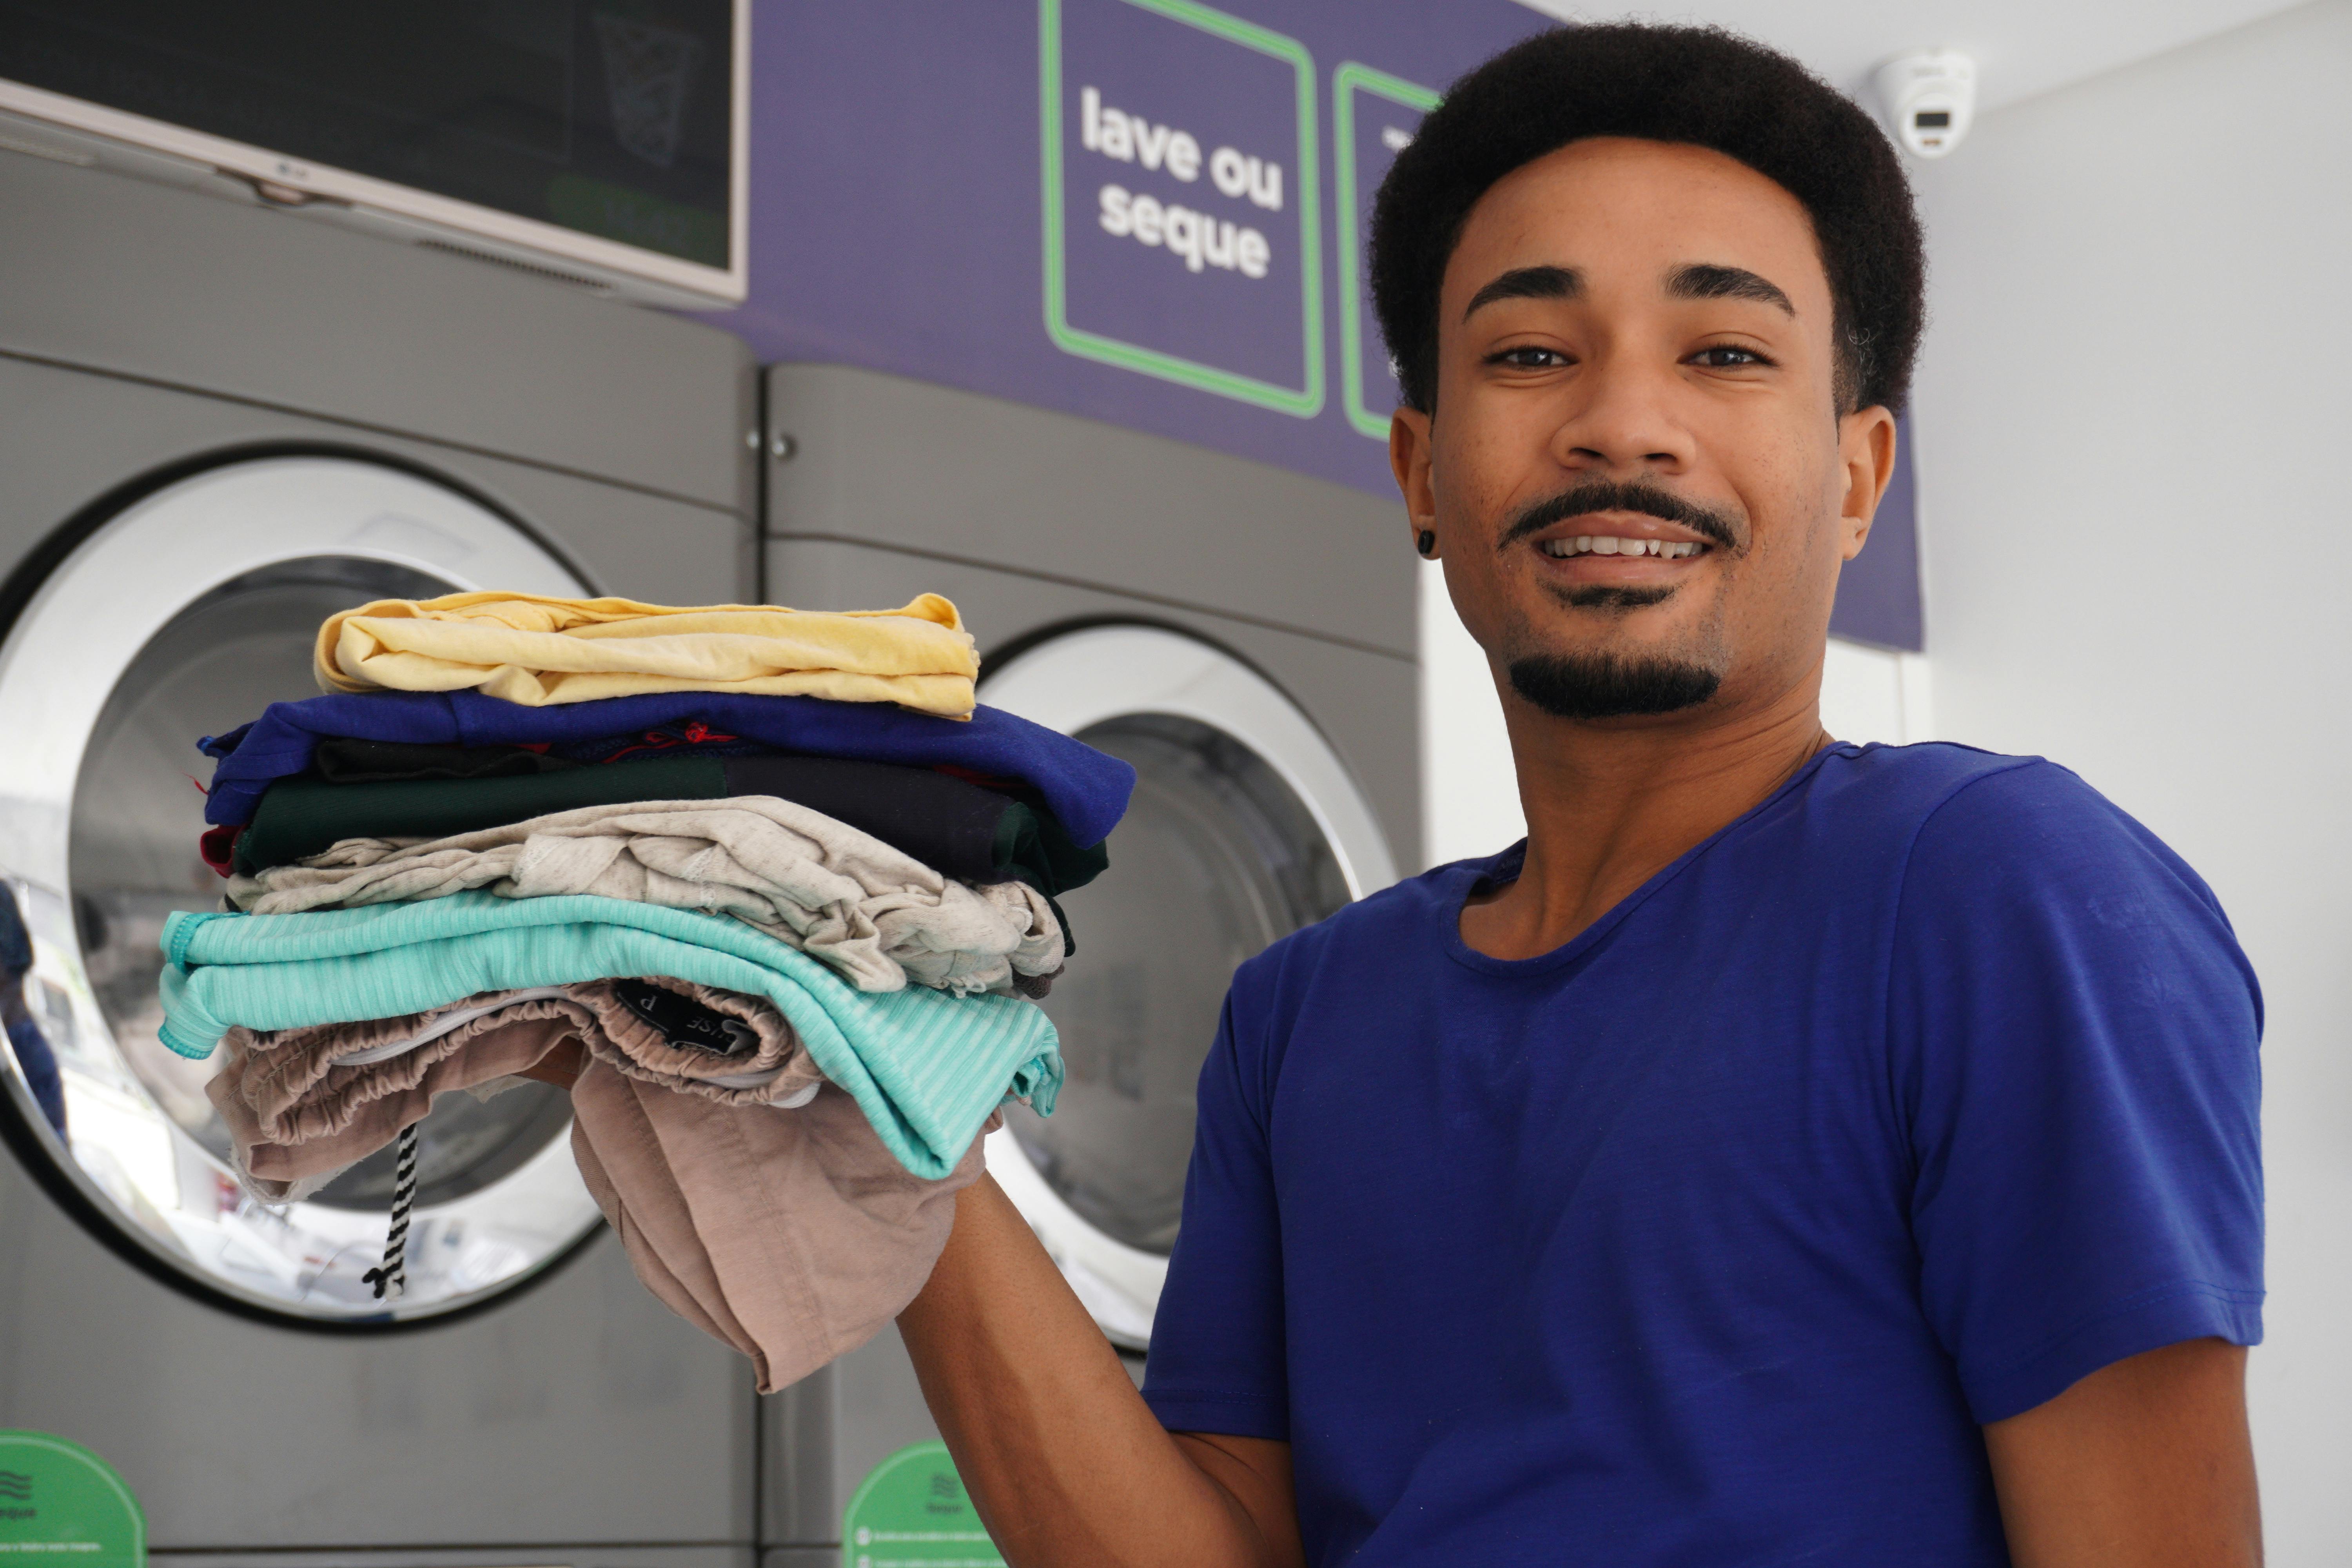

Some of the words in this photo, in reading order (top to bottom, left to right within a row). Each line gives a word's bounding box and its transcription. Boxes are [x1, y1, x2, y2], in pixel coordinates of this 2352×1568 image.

[1082, 87, 1202, 182] lave
[1210, 147, 1283, 211] ou
[1099, 184, 1270, 278] seque
[640, 994, 658, 1012] P
